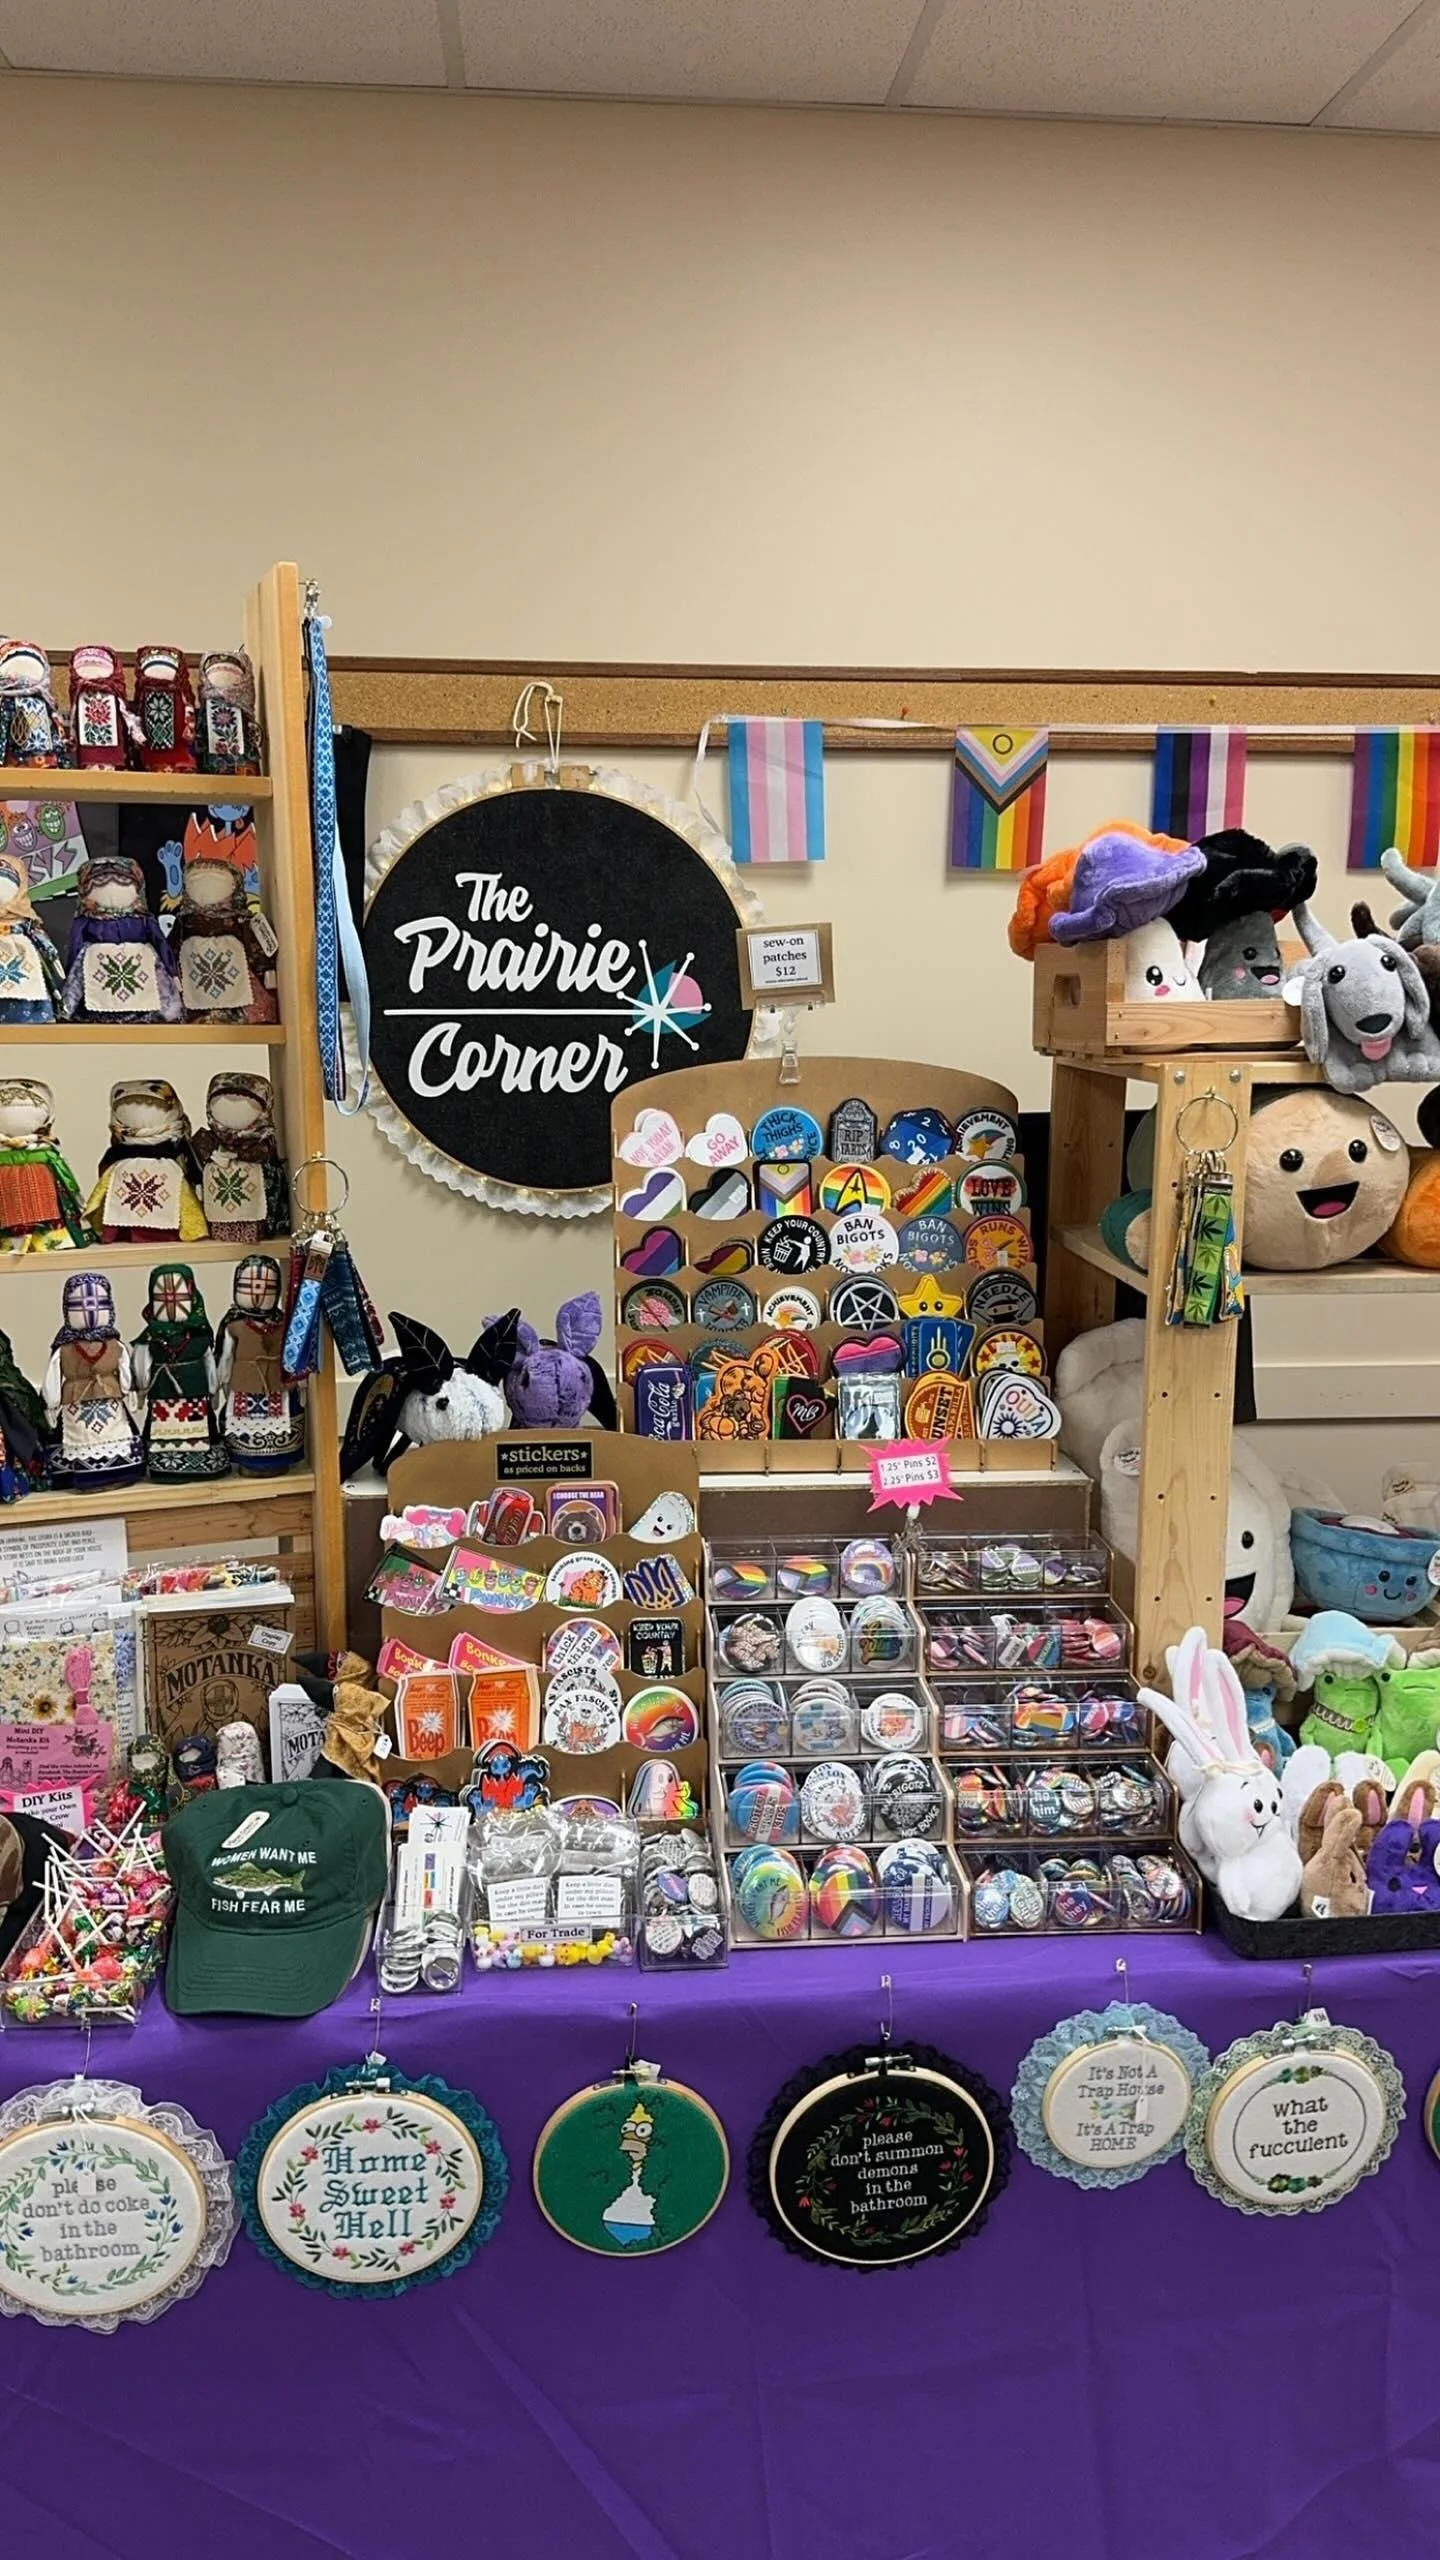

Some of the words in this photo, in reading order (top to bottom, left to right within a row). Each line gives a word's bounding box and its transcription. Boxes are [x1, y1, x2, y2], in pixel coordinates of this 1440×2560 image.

[455, 872, 533, 922] The
[763, 936, 805, 948] sew-on
[394, 916, 636, 993] Prairie
[763, 951, 807, 965] patches
[776, 966, 796, 977] $12
[408, 1022, 629, 1097] Corner
[760, 1112, 799, 1133] THICK
[921, 1117, 931, 1127] 2
[647, 1121, 674, 1149] TODAY
[706, 1132, 725, 1151] GO
[764, 1123, 803, 1143] THIGHS
[708, 1135, 741, 1167] AWAY
[971, 1178, 1013, 1197] LOVE
[970, 1199, 1011, 1216] WINS
[844, 1218, 874, 1232] BAN
[918, 1219, 947, 1232] BAN
[763, 1222, 783, 1243] KEEP
[784, 1219, 808, 1231] YOUR
[807, 1225, 827, 1265] COUNTRY
[836, 1230, 885, 1245] BIGOTS
[907, 1230, 955, 1245] BIGOTS
[980, 1221, 1016, 1237] RUNS
[1016, 1235, 1030, 1270] WITH
[697, 1284, 746, 1306] VAMPIRE
[974, 1286, 1032, 1310] NEEDLE
[766, 1294, 815, 1317] ACHIEVEMENT
[932, 1386, 954, 1439] UNSET
[1006, 1390, 1046, 1433] OUIJA
[509, 1445, 580, 1462] stickers
[904, 1459, 923, 1468] Pins
[925, 1456, 936, 1466] $2
[504, 1466, 514, 1474] as
[516, 1464, 544, 1476] priced
[546, 1465, 558, 1473] on
[560, 1463, 586, 1473] backs
[905, 1472, 924, 1483] Pins
[928, 1469, 939, 1480] $3
[557, 1491, 579, 1500] CHOOSE
[579, 1491, 589, 1499] THE
[589, 1491, 605, 1499] BEAR
[636, 1630, 676, 1640] COUNTRY
[656, 1622, 680, 1631] YOUR
[552, 1633, 576, 1665] thick
[567, 1630, 598, 1665] thighs
[164, 1651, 280, 1701] MOTANKA
[553, 1696, 573, 1718] BAN
[575, 1694, 616, 1725] FASCISTS
[6, 1736, 37, 1744] Motanka
[39, 1736, 50, 1744] Kit
[288, 1730, 326, 1759] MOTA
[407, 1719, 445, 1753] Beep
[22, 1795, 47, 1808] DIY
[49, 1791, 73, 1803] Kits
[1034, 1791, 1051, 1802] he
[41, 1806, 58, 1815] your
[59, 1803, 77, 1811] Own
[49, 1813, 70, 1821] Crow
[774, 1805, 787, 1831] KIDS
[917, 1805, 940, 1832] BOOKS
[211, 1849, 258, 1867] WOMEN
[259, 1847, 296, 1863] WANT
[297, 1851, 318, 1865] ME
[211, 1898, 239, 1913] FISH
[242, 1900, 280, 1914] FEAR
[284, 1899, 306, 1913] ME
[527, 1930, 548, 1939] For
[551, 1928, 585, 1938] Trade
[1088, 2066, 1114, 2081] It's
[1116, 2064, 1144, 2080] Not
[1145, 2063, 1159, 2079] A
[1078, 2084, 1114, 2100] Trap
[1273, 2096, 1328, 2118] what
[1076, 2122, 1102, 2137] It's
[1104, 2121, 1117, 2135] A
[1119, 2121, 1155, 2137] Trap
[1281, 2118, 1318, 2135] the
[863, 2129, 914, 2150] please
[1089, 2137, 1137, 2151] HOME
[1249, 2133, 1348, 2159] fucculent
[322, 2146, 427, 2175] Home
[830, 2151, 872, 2168] don't
[875, 2144, 944, 2163] summon
[857, 2163, 918, 2180] demons
[51, 2176, 117, 2199] plese
[319, 2177, 430, 2213] Sweet
[865, 2181, 882, 2196] in
[884, 2178, 912, 2193] the
[23, 2201, 74, 2219] don't
[78, 2198, 101, 2215] do
[106, 2195, 150, 2213] coke
[850, 2193, 928, 2215] bathroom
[60, 2222, 81, 2239] in
[84, 2219, 117, 2236] the
[333, 2208, 413, 2241] Hell
[40, 2242, 141, 2264] bathroom
